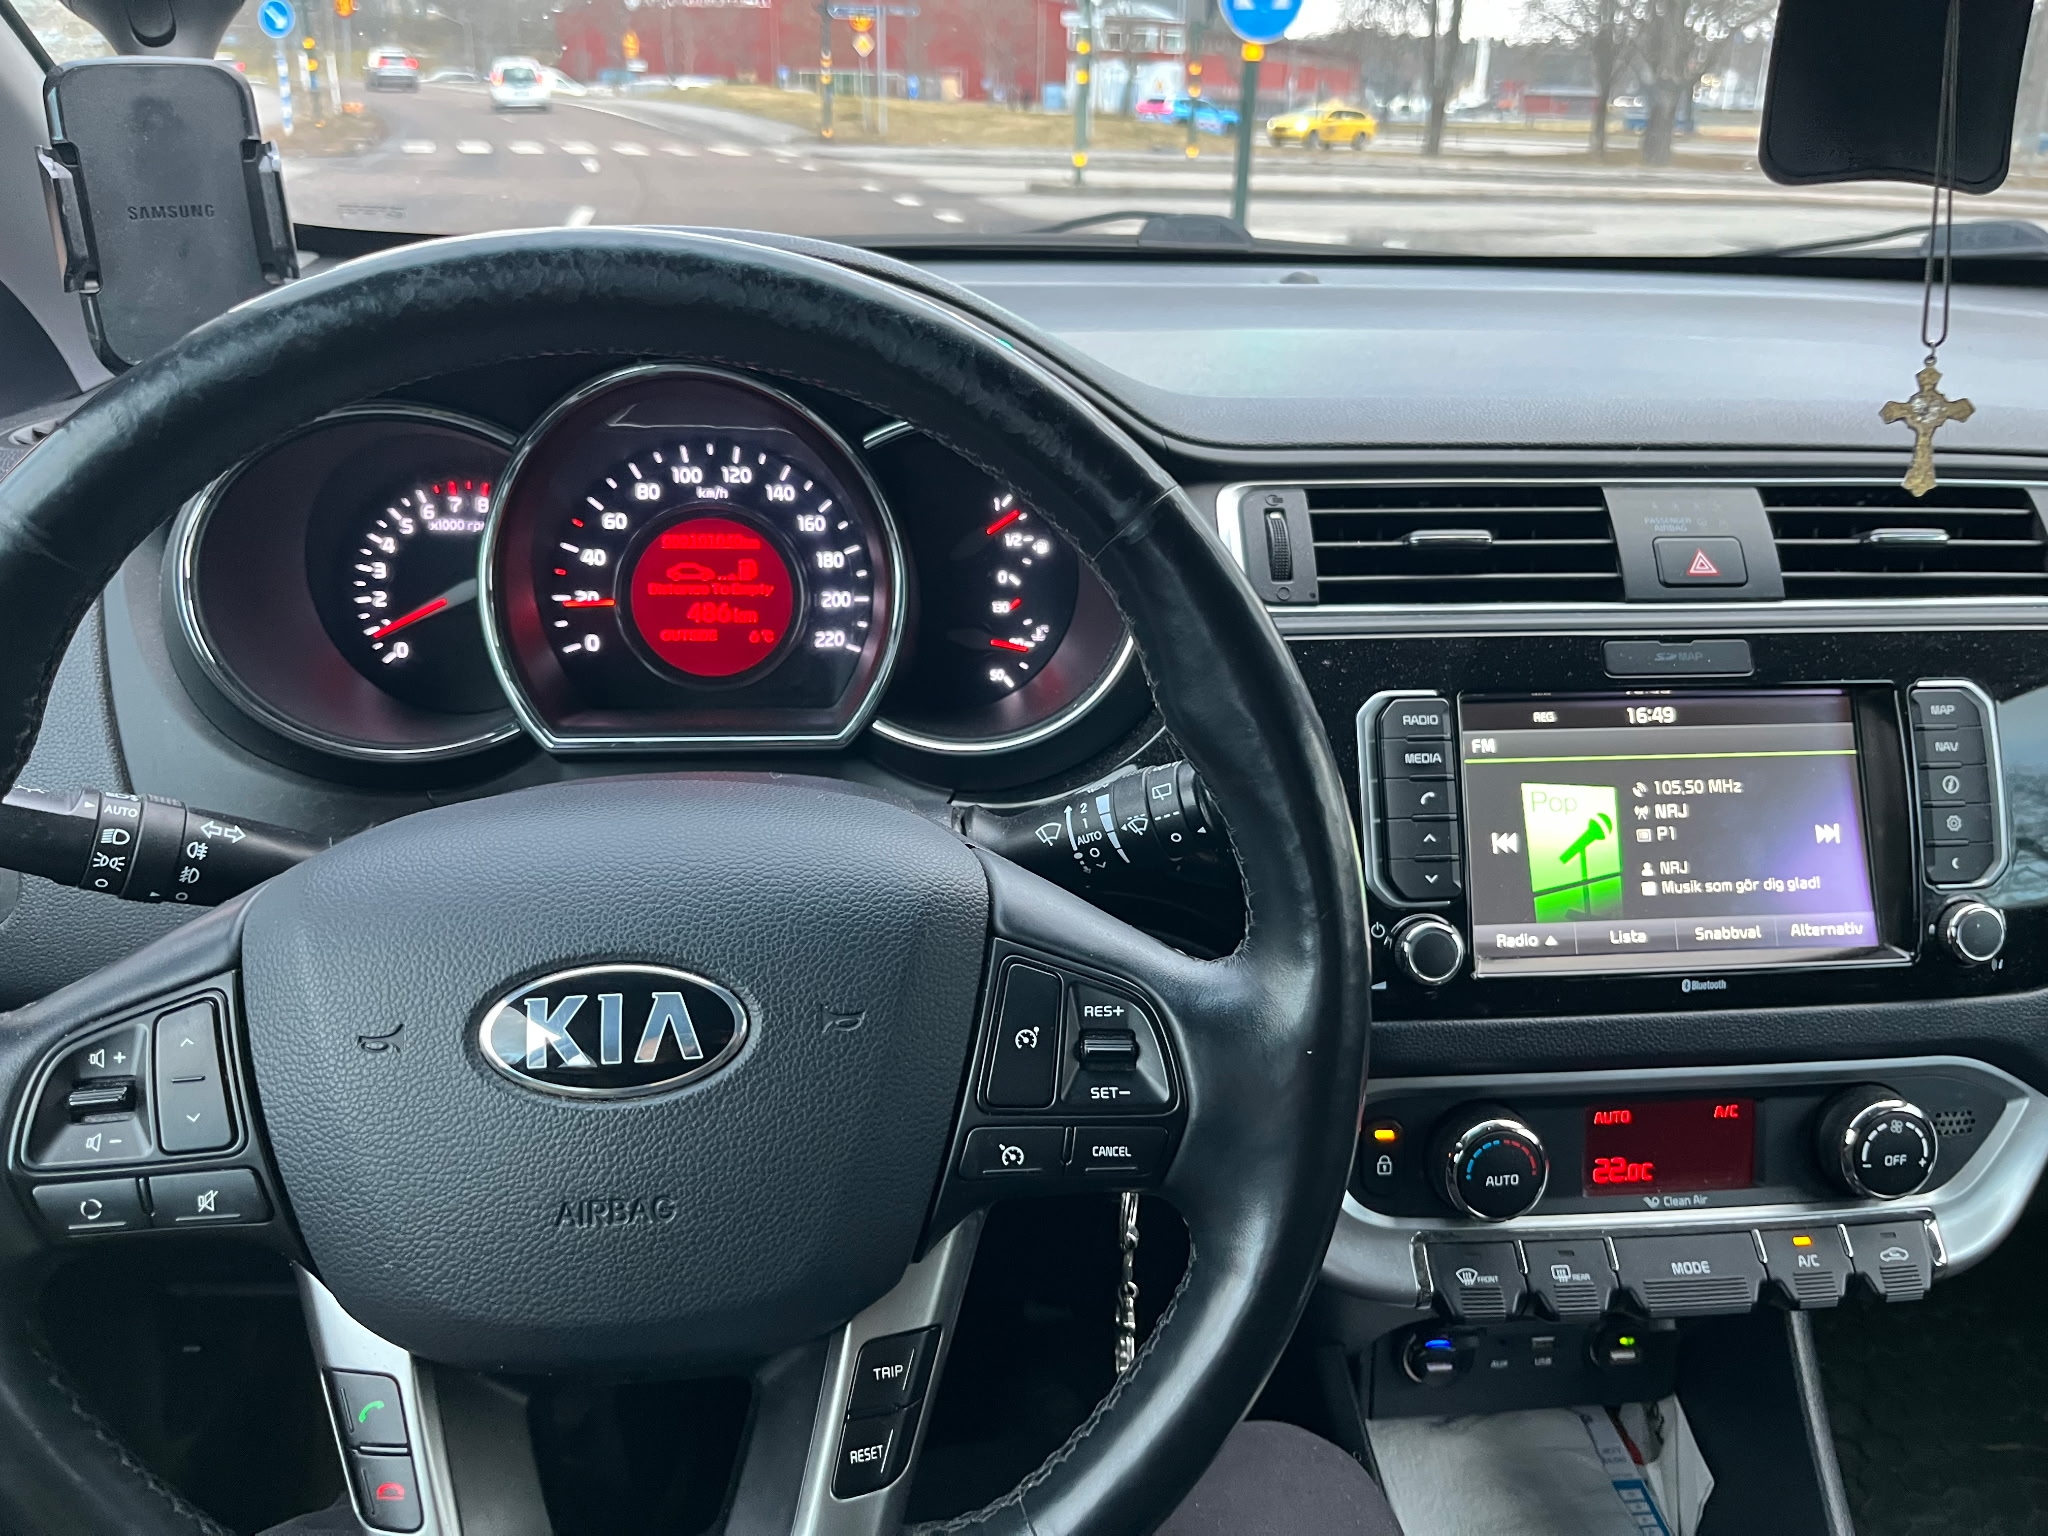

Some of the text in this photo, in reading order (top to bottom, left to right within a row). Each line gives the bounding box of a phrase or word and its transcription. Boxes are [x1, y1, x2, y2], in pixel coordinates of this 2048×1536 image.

[127, 204, 215, 220] SAMSUNG
[671, 466, 703, 484] 100
[720, 466, 752, 484] 120
[635, 483, 660, 500] 80
[696, 486, 729, 500] km/h
[765, 484, 795, 501] 140
[420, 503, 435, 519] 6
[448, 496, 462, 513] 7
[475, 496, 489, 513] 8
[399, 518, 414, 534] 5
[428, 519, 465, 531] x1000
[601, 512, 627, 530] 60
[797, 514, 826, 532] 160
[380, 537, 396, 553] 4
[1005, 533, 1022, 546] 1/2
[580, 549, 606, 566] 40
[817, 551, 844, 568] 180
[371, 562, 387, 579] 3
[997, 570, 1008, 584] 0
[648, 583, 774, 597] Distance To Empty
[372, 591, 387, 608] 2
[821, 591, 851, 608] 200
[687, 602, 758, 624] 486 km
[584, 634, 600, 652] 0
[660, 629, 718, 642] OUTSIDE
[815, 630, 845, 648] 220
[393, 641, 409, 659] 0
[1678, 652, 1704, 661] MAP
[990, 669, 1005, 681] 50
[1532, 706, 1676, 725] REG 16:49
[1930, 704, 1955, 715] MAP
[1402, 714, 1439, 726] RADIO
[1471, 738, 1496, 753] FM
[1934, 741, 1959, 752] NAV
[1404, 752, 1442, 764] MEDIA
[1708, 779, 1744, 794] MHz
[104, 803, 138, 818] AUTO
[1080, 803, 1088, 814] 2
[1531, 791, 1577, 815] Pop
[1654, 803, 1689, 819] NRJ
[1082, 818, 1088, 829] 1
[1077, 830, 1102, 846] AUTO
[1656, 826, 1677, 841] P1
[1659, 861, 1690, 875] NRJ
[1661, 876, 1821, 895] Musik som gör dig glad!
[1495, 922, 1863, 948] Radio Lista Snabbval Alternativ
[1692, 979, 1727, 991] Bluetooth
[1084, 1005, 1125, 1017] RES+
[524, 992, 703, 1069] KIA
[1593, 1104, 1739, 1125] AUTO A/C
[1092, 1146, 1132, 1157] CANCEL
[1884, 1154, 1907, 1167] OFF
[1485, 1174, 1519, 1187] AUTO
[1663, 1194, 1708, 1207] Clean Air
[555, 1196, 678, 1228] AIRBAG
[1671, 1260, 1711, 1275] MODE
[1798, 1254, 1820, 1268] A/C
[1477, 1275, 1499, 1284] FRONT
[873, 1364, 903, 1381] TRIP
[850, 1444, 883, 1464] RESET
